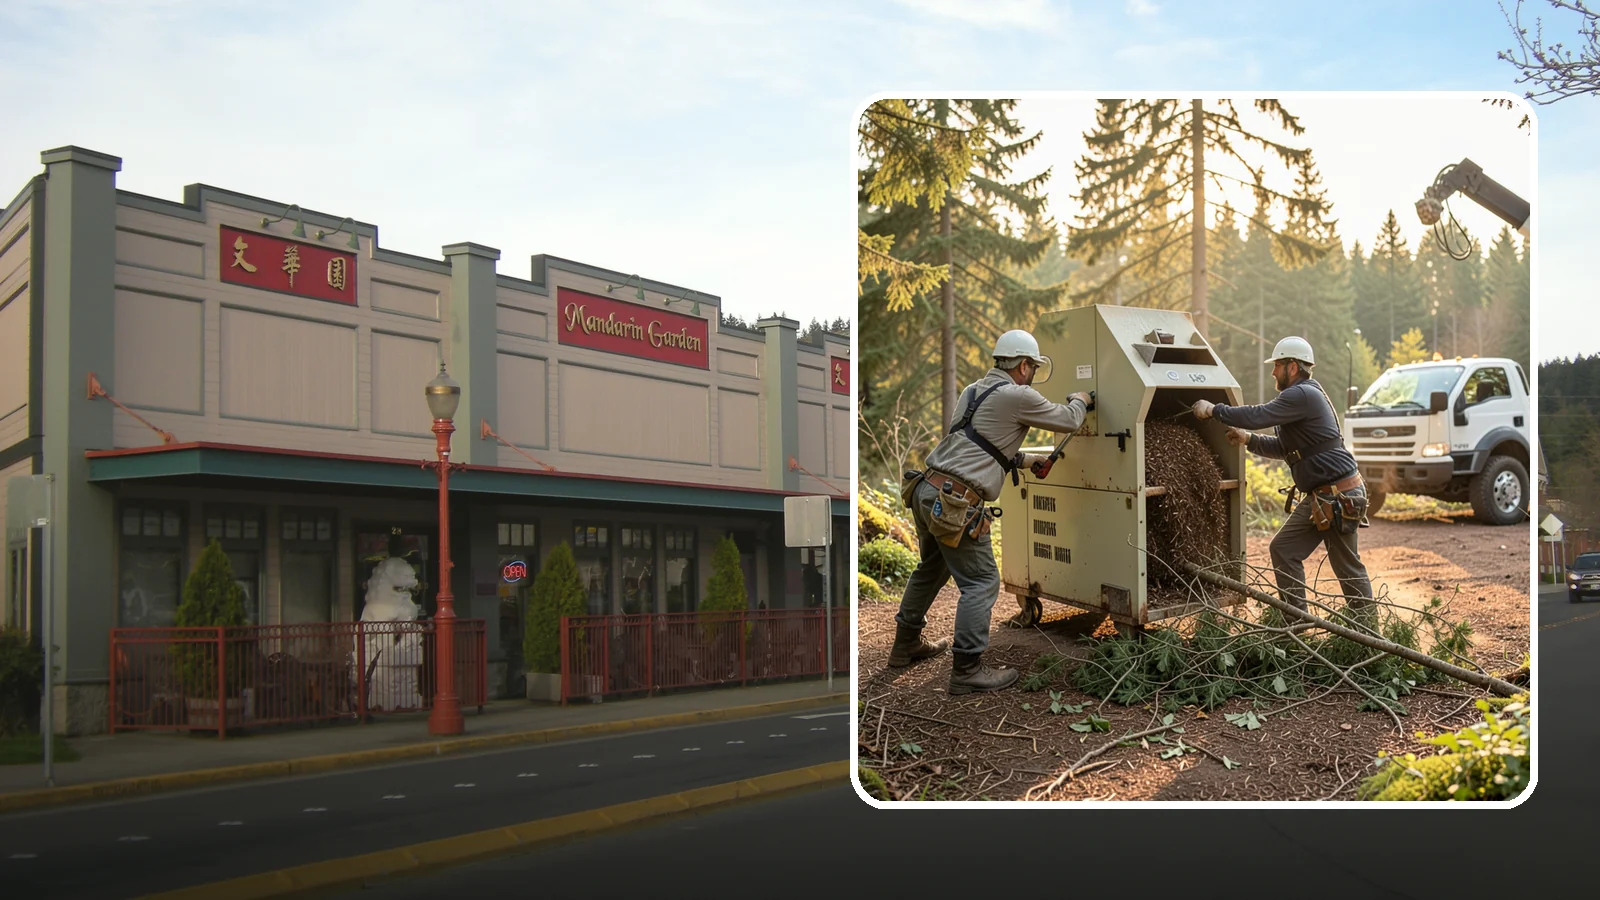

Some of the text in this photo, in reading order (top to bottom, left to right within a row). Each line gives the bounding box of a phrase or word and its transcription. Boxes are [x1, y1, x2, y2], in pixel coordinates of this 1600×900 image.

[231, 235, 346, 291] 文華園
[564, 302, 702, 352] Mandarin Garden
[503, 565, 527, 578] OPEN
